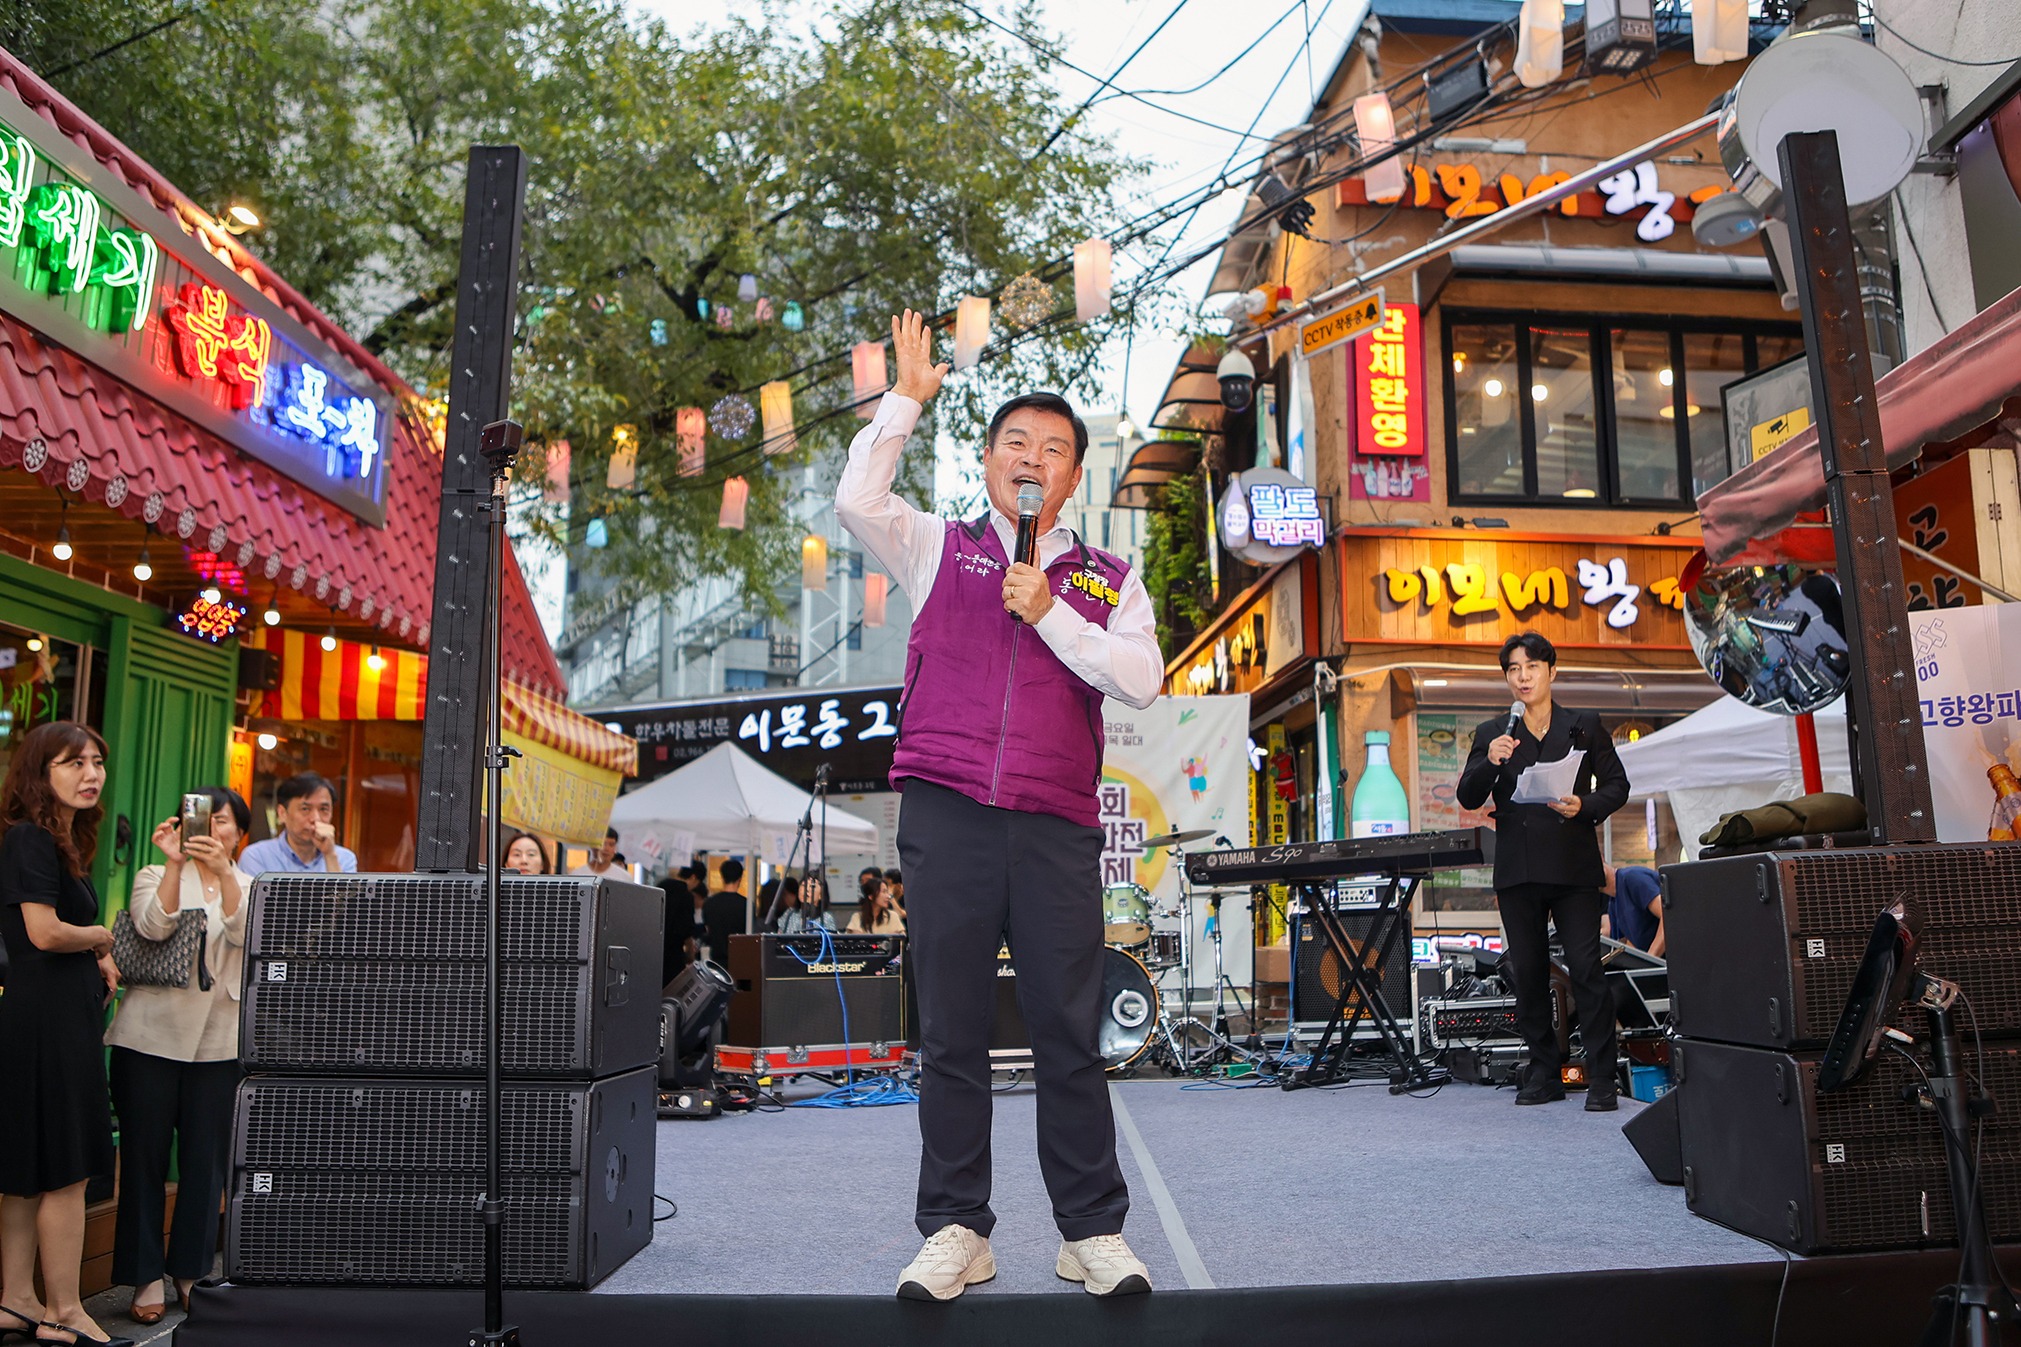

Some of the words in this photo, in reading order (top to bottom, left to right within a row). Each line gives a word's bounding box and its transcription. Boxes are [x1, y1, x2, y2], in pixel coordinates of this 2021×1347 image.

[1304, 323, 1334, 346] CCTV
[1335, 311, 1363, 332] 작동중
[186, 285, 271, 408] 분식
[287, 362, 379, 478] 포차
[1368, 308, 1409, 448] 단체환영
[1250, 485, 1319, 518] 팔도
[1252, 519, 1324, 546] 막걸리
[1072, 571, 1119, 606] 이필형
[1386, 563, 1569, 616] 이모네
[1915, 653, 1936, 666] FRESH
[1918, 661, 1940, 682] 0.0
[634, 717, 730, 743] 한우차돌전문
[738, 699, 850, 753] 이문동
[857, 700, 901, 742] 그
[1104, 723, 1134, 734] 금요일
[1104, 736, 1118, 746] 목
[1122, 736, 1143, 746] 일대
[1218, 851, 1256, 866] YAMAHA
[1261, 848, 1303, 865] S90
[1812, 939, 1823, 955] HK
[274, 964, 285, 979] HK
[807, 962, 867, 974] Blackstar
[1832, 1145, 1843, 1160] HK
[258, 1175, 272, 1191] HK
